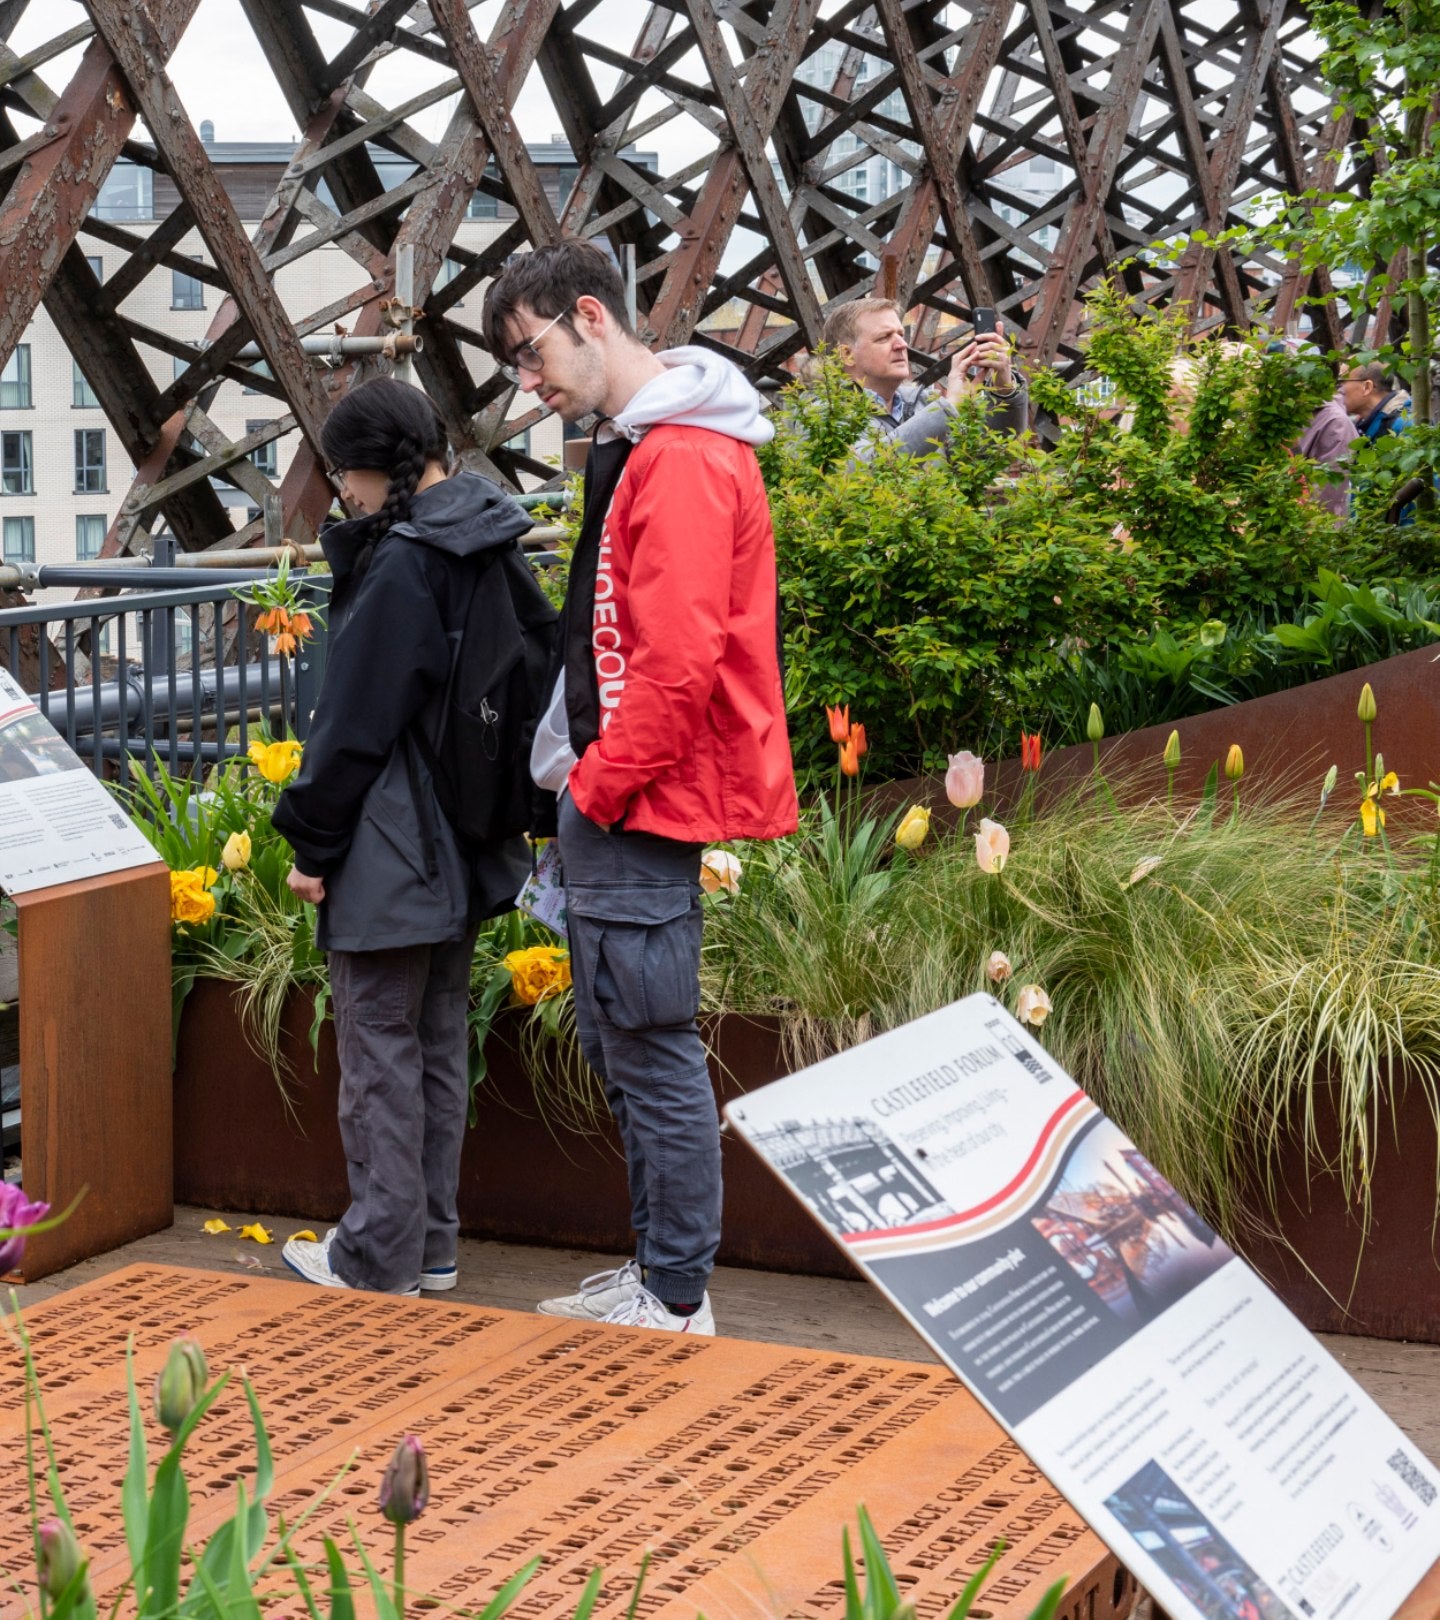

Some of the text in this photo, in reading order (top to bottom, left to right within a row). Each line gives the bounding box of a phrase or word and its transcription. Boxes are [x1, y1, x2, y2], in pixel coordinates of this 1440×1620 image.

[868, 1041, 1005, 1119] CASTLEFIELD FORUM
[92, 1294, 147, 1311] AND
[133, 1273, 195, 1294] VAST
[99, 1270, 165, 1292] FROM
[109, 1277, 224, 1321] BEAUTIFUL
[921, 1287, 961, 1318] Welcome
[970, 1254, 1015, 1289] community
[1003, 1244, 1029, 1268] plot
[62, 1328, 145, 1359] GRADE
[134, 1309, 189, 1328] ONE
[177, 1281, 254, 1309] LISTED
[83, 1348, 143, 1369] AND
[129, 1313, 221, 1348] CHARM.
[265, 1320, 369, 1364] POWERED
[358, 1302, 409, 1319] THE
[44, 1389, 138, 1426] TRAMS
[185, 1311, 307, 1361] ISS-CROSS
[294, 1293, 346, 1311] THE
[66, 1425, 109, 1438] IN
[299, 1297, 378, 1328] WHERE
[89, 1448, 153, 1472] AN
[141, 1378, 294, 1446] HOIZONTALS
[279, 1350, 351, 1378] MEET
[335, 1338, 375, 1350] IN
[359, 1306, 441, 1338] LAYERS
[265, 1339, 415, 1407] PROGRESSION.
[401, 1310, 473, 1339] LAYER
[279, 1397, 347, 1423] PAST
[331, 1347, 442, 1396] UNRAVELS
[429, 1314, 506, 1346] BEFORE
[456, 1420, 533, 1454] BASIN
[518, 1384, 595, 1419] ITSELF
[580, 1337, 677, 1383] PROVIDES
[765, 1379, 829, 1409] HOME
[809, 1361, 858, 1380] FOR
[824, 1365, 896, 1401] PEOPLE
[254, 1426, 337, 1461] EARS
[323, 1410, 367, 1425] OF
[349, 1367, 449, 1411] HISTORY.
[303, 1462, 366, 1487] AND
[349, 1413, 453, 1462] WALKING
[436, 1386, 502, 1413] OVER
[485, 1366, 539, 1386] THE
[521, 1328, 608, 1367] COBBLES
[336, 1478, 384, 1495] OF
[460, 1361, 590, 1425] CASTLEFIELD
[576, 1332, 643, 1360] FEELS
[412, 1474, 490, 1509] SAME
[473, 1443, 542, 1473] TIME
[525, 1430, 564, 1442] IS
[547, 1398, 617, 1429] MORE
[649, 1341, 712, 1368] MORE
[680, 1418, 772, 1465] PROVIDE
[750, 1409, 785, 1419] A
[826, 1397, 944, 1467] APARTMENTS
[406, 1528, 450, 1543] IS
[432, 1515, 471, 1527] A
[453, 1476, 535, 1514] PLACE
[517, 1459, 563, 1475] TO
[546, 1420, 627, 1458] LINGER
[610, 1377, 696, 1419] LONGER.
[480, 1526, 557, 1562] THAT
[539, 1487, 617, 1524] MADE
[597, 1403, 746, 1485] MANCHESTER'S
[629, 1516, 728, 1570] MODERN
[800, 1391, 905, 1451] INNOVATION
[883, 1371, 933, 1392] AND
[638, 1465, 701, 1493] NOW
[664, 1472, 740, 1510] SENSE
[719, 1456, 764, 1472] OF
[646, 1510, 686, 1522] A
[838, 1503, 955, 1577] MMERCE
[931, 1437, 1036, 1503] CASTLEFIE
[551, 1521, 669, 1586] CREATING
[974, 1575, 1034, 1605] THE
[1009, 1521, 1094, 1574] FUTURE
